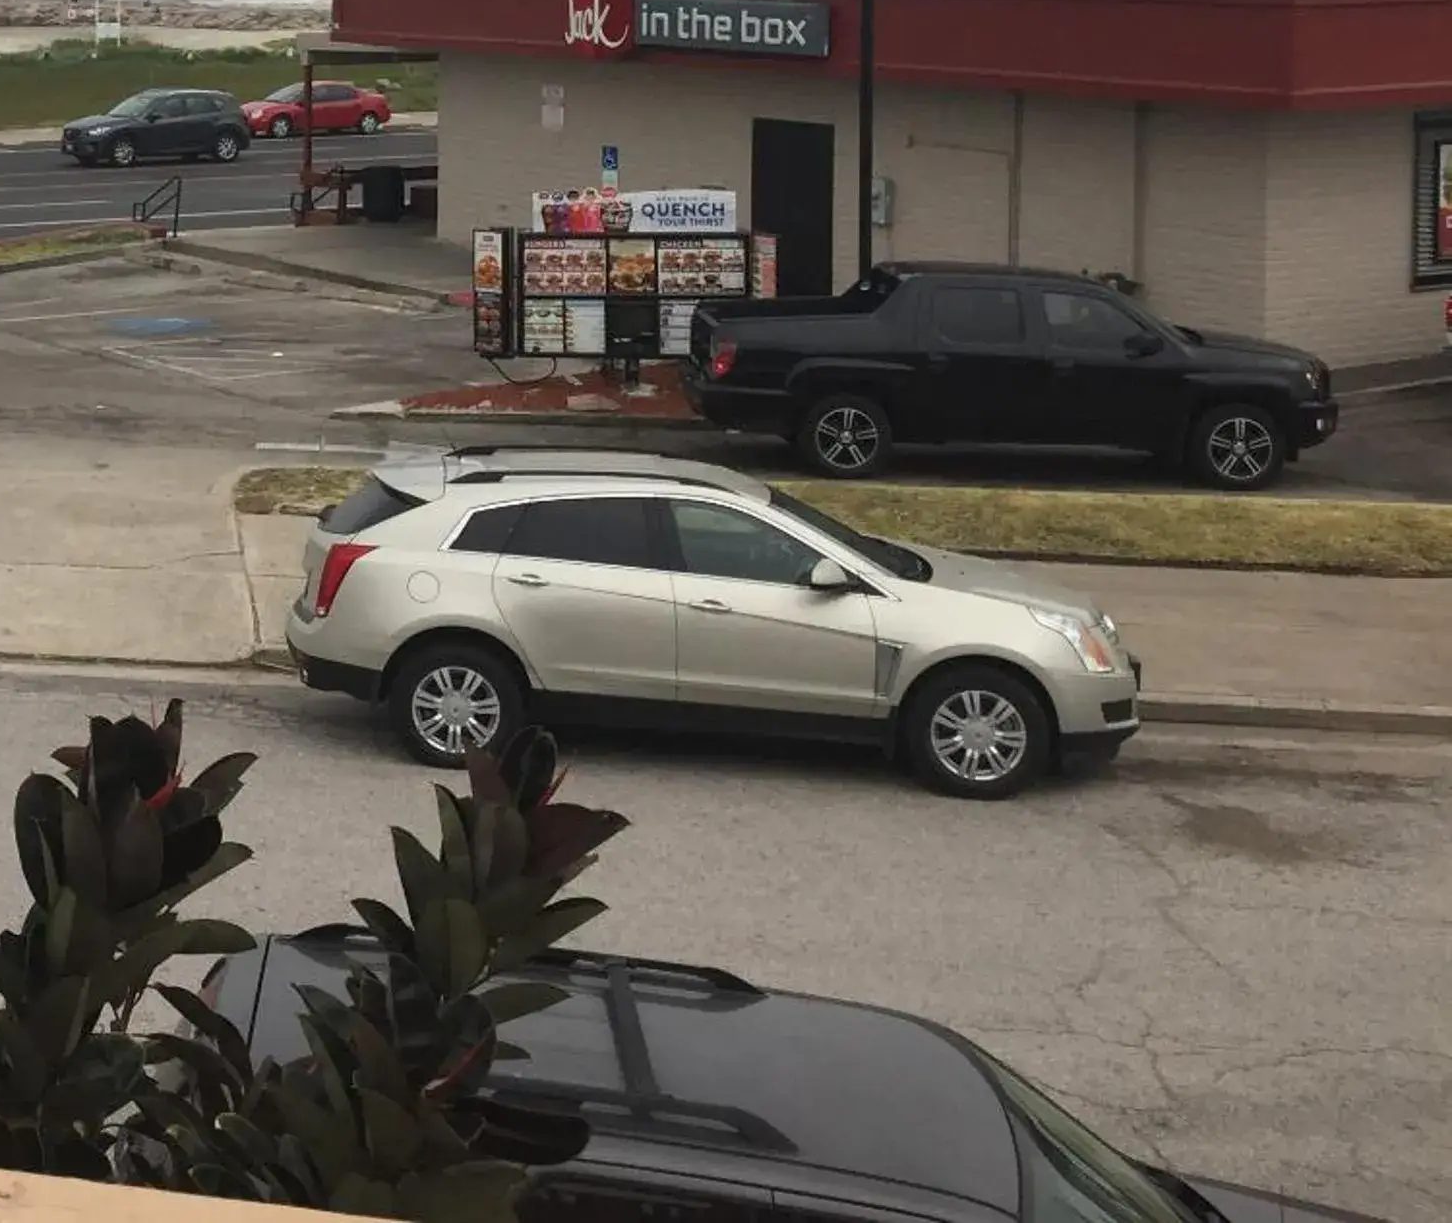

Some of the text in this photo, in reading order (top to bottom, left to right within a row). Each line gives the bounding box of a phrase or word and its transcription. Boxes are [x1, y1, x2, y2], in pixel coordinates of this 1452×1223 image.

[640, 3, 669, 38] in
[677, 7, 732, 42] the
[740, 10, 807, 47] box
[641, 201, 725, 220] QUENCH
[657, 218, 725, 227] YOUR THIRST
